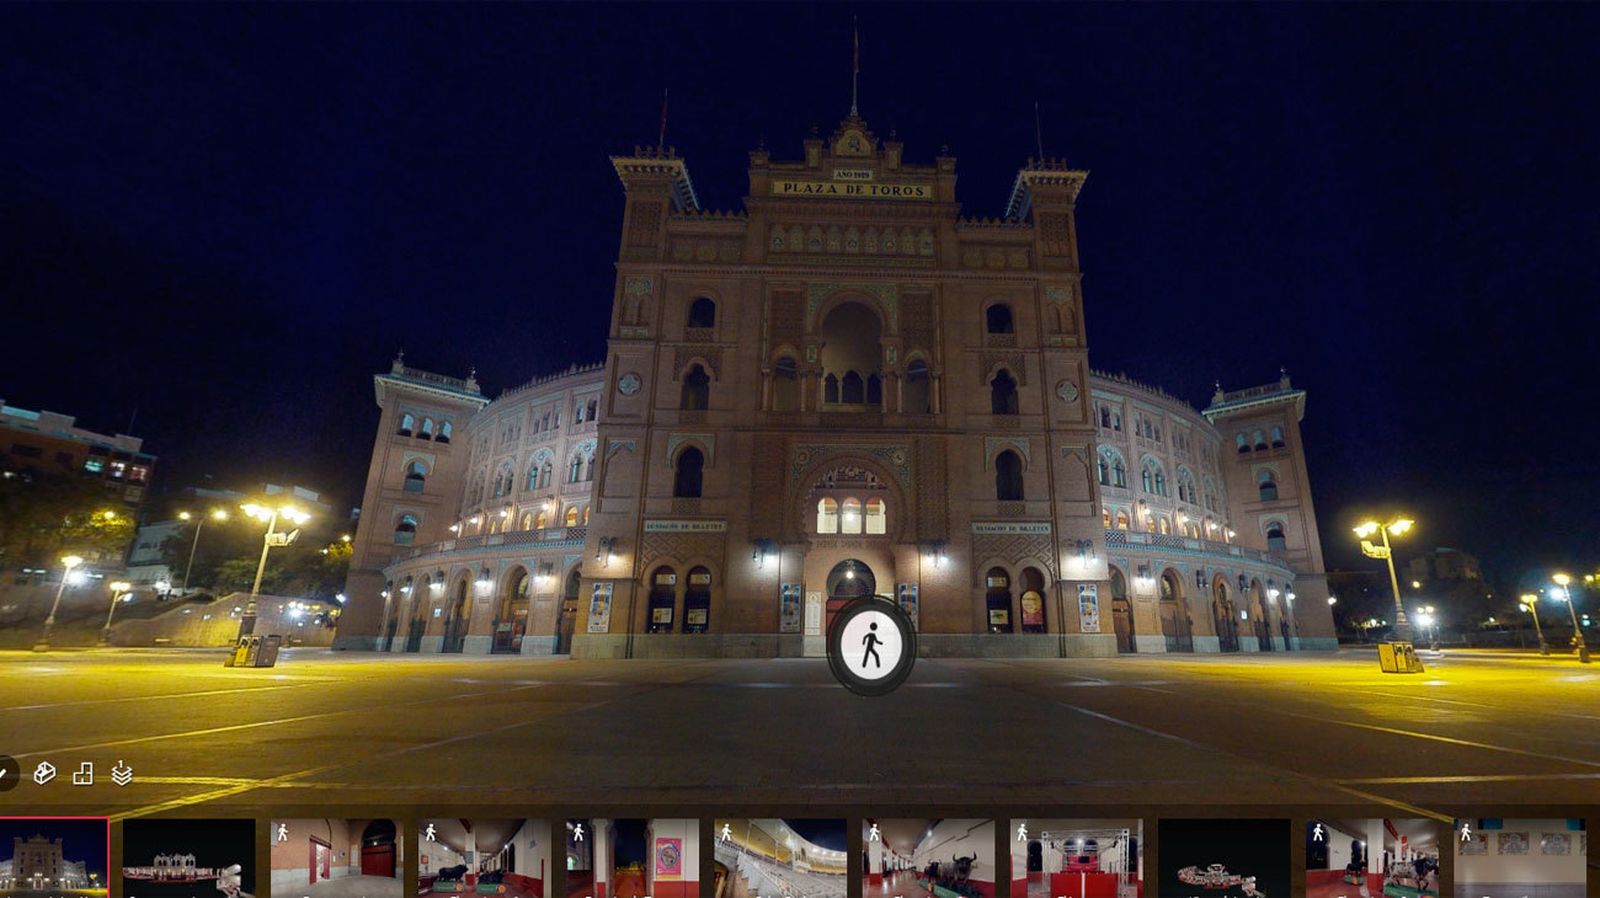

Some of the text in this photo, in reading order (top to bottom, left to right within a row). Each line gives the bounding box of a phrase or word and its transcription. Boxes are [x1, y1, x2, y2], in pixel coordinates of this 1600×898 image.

[783, 183, 924, 196] PLAZA DE TOROS
